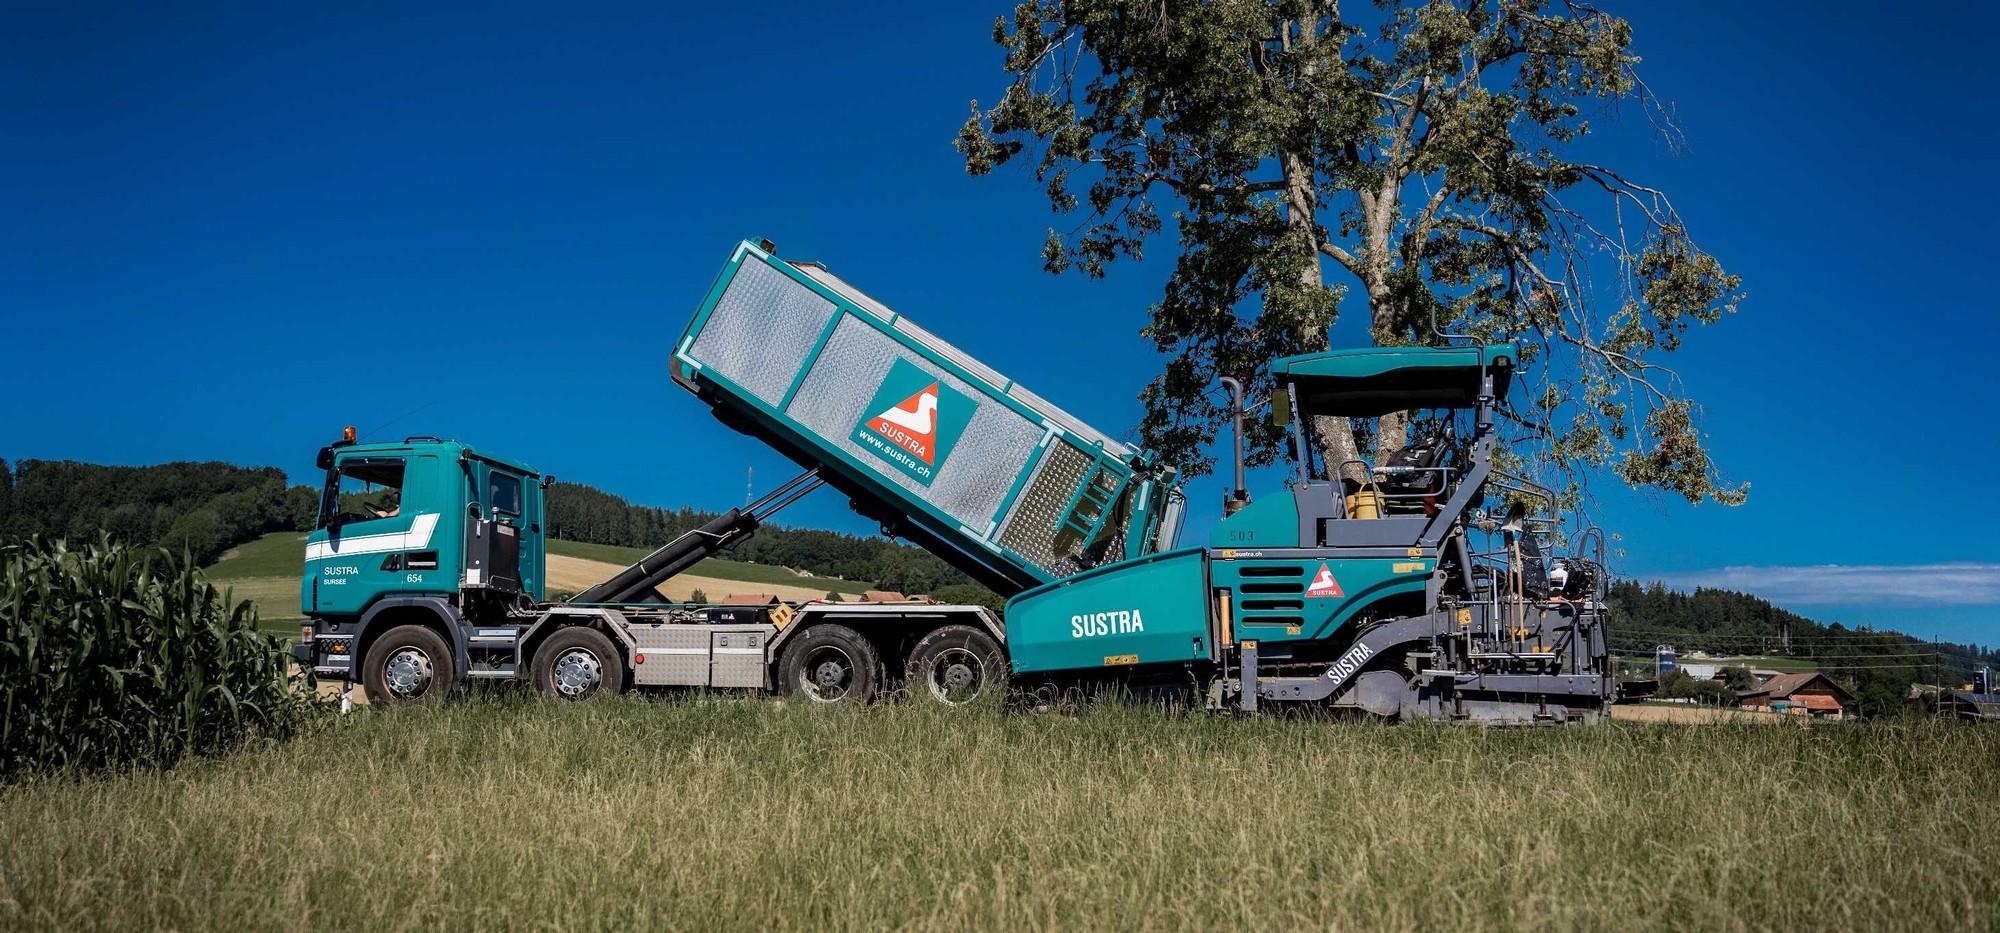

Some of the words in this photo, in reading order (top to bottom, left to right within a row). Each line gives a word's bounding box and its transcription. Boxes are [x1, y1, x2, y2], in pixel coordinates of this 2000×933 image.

[880, 422, 926, 456] SUSTRA
[859, 430, 930, 478] www.sustra.ch
[1230, 530, 1254, 541] 503
[324, 566, 359, 575] SUSTRA
[407, 574, 422, 583] 654
[1071, 609, 1144, 638] SUSTRA
[1327, 642, 1374, 684] SUSTRA
